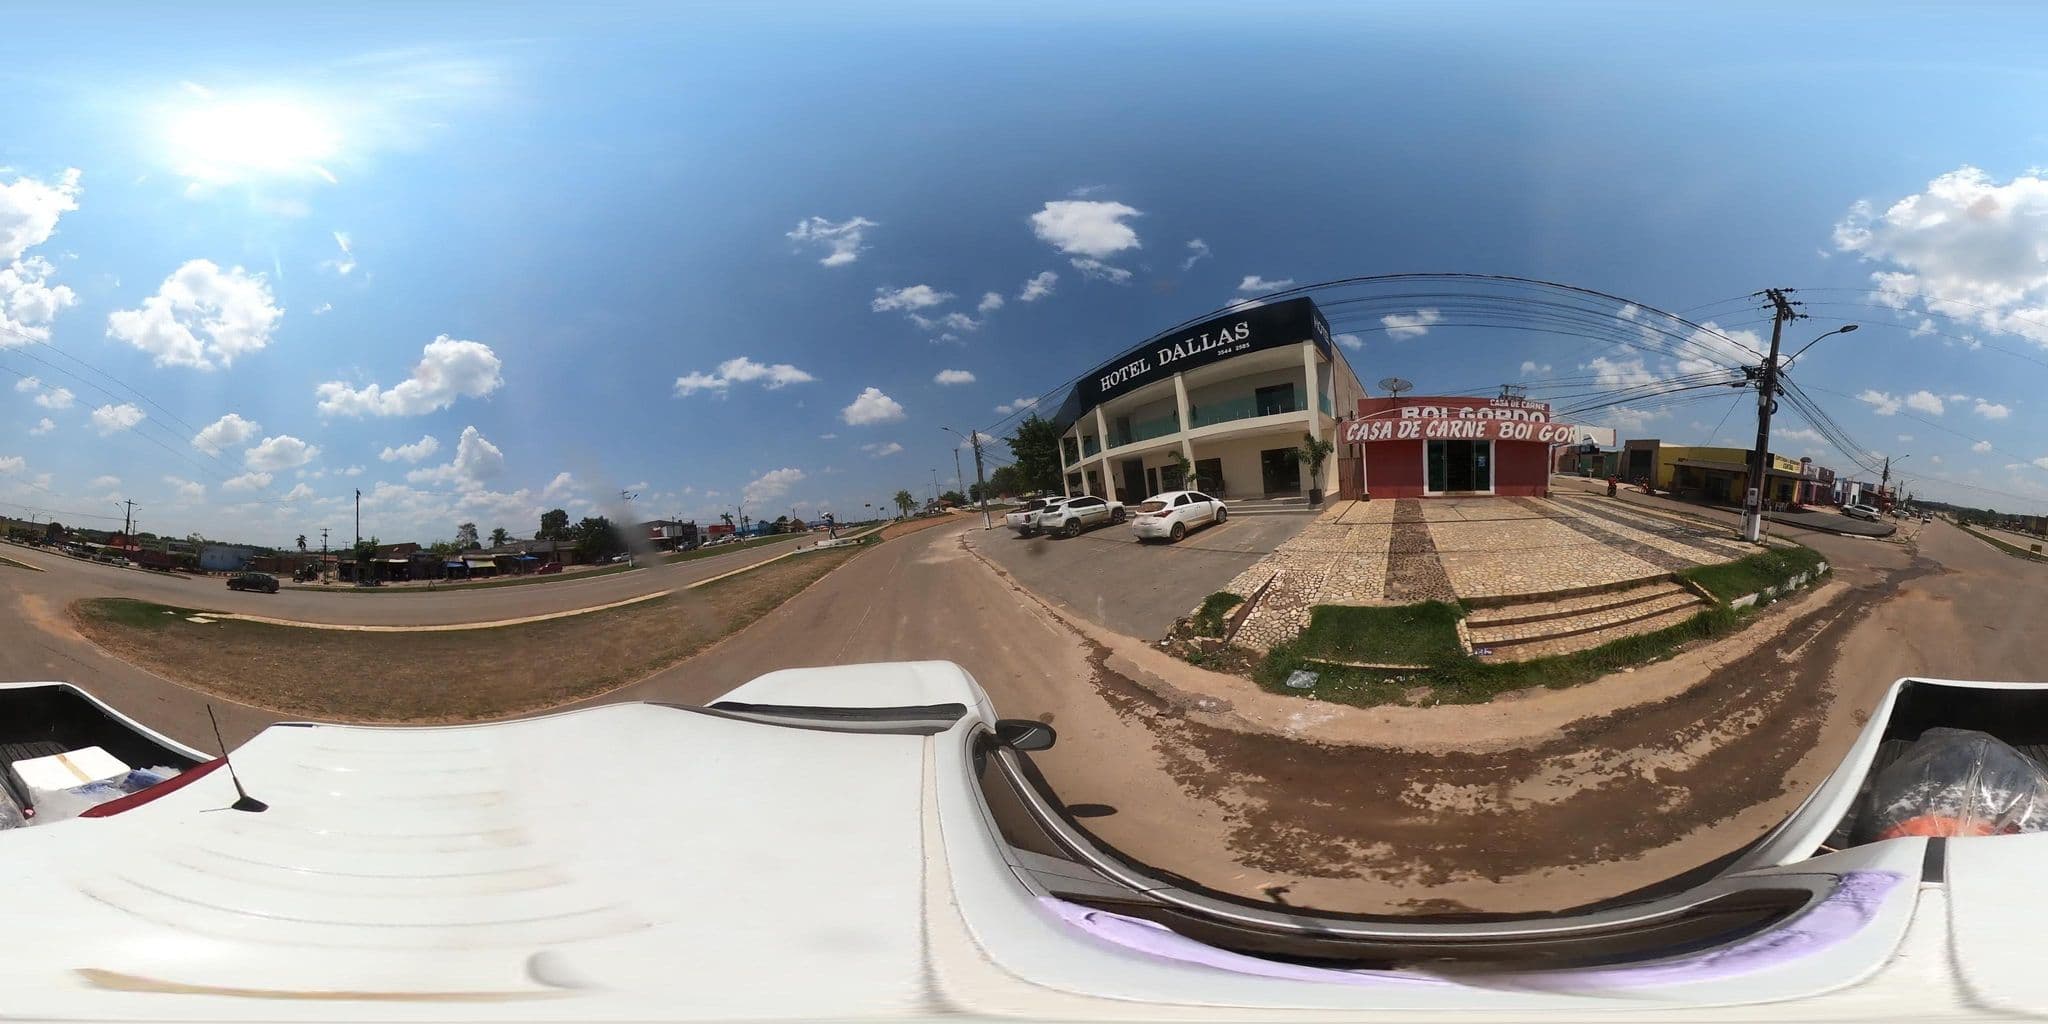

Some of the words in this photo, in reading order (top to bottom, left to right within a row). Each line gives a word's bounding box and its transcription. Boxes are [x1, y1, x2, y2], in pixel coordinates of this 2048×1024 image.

[1100, 358, 1151, 392] HOTEL
[1157, 321, 1250, 366] DALLAS
[1490, 399, 1509, 407] CASA
[1510, 400, 1521, 409] DE
[1521, 400, 1546, 411] CARNE
[1346, 421, 1393, 441] CASA
[1397, 420, 1422, 438] DE
[1425, 420, 1487, 438] CARNE
[1499, 422, 1531, 440] BOI
